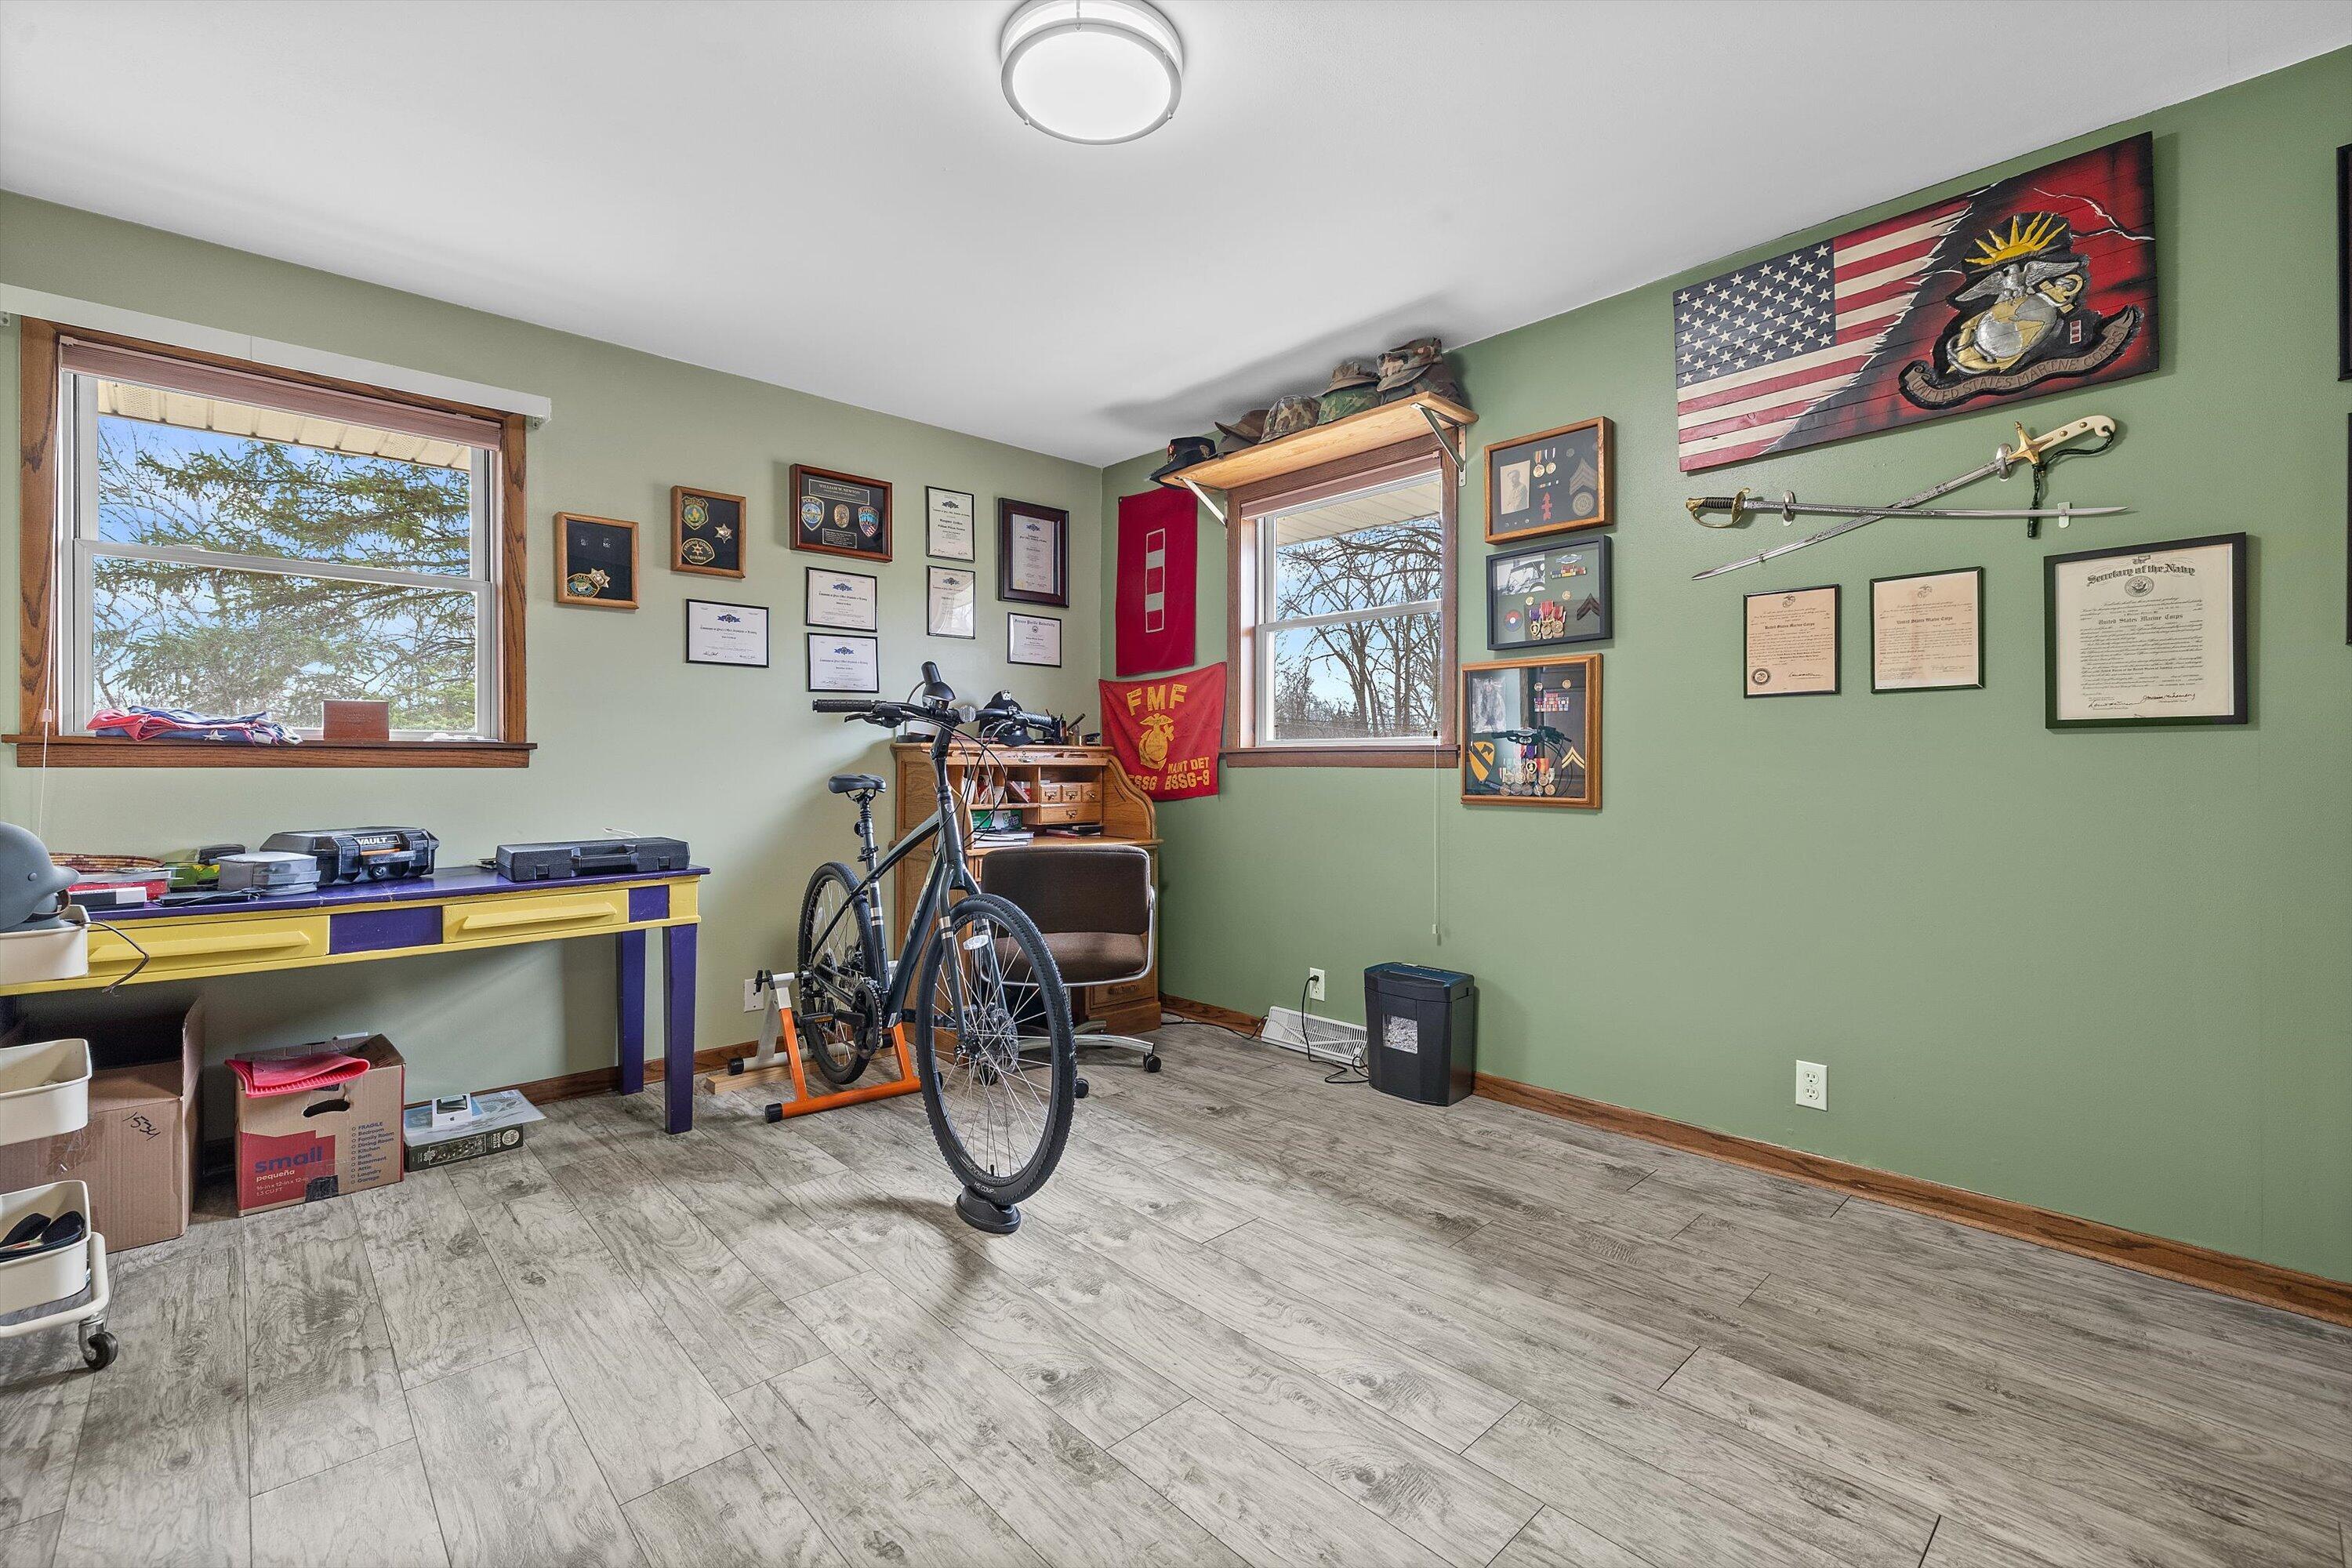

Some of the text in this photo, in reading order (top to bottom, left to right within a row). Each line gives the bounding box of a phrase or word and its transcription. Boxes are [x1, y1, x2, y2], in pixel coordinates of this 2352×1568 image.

[1911, 330, 2125, 401] UNITED STATES MARINE CORPS
[2086, 563, 2195, 586] Secretary of the Navy
[1126, 684, 1188, 717] FMF
[1167, 757, 1210, 774] MAINT DET
[357, 837, 387, 845] VAULT
[358, 1121, 383, 1130] FRAGILE
[358, 1127, 385, 1136] Bedroom
[358, 1145, 380, 1154] Kitchen
[255, 1147, 323, 1173] small
[358, 1156, 387, 1166] Basement
[256, 1168, 296, 1183] pequeña
[358, 1169, 381, 1178] Laundry
